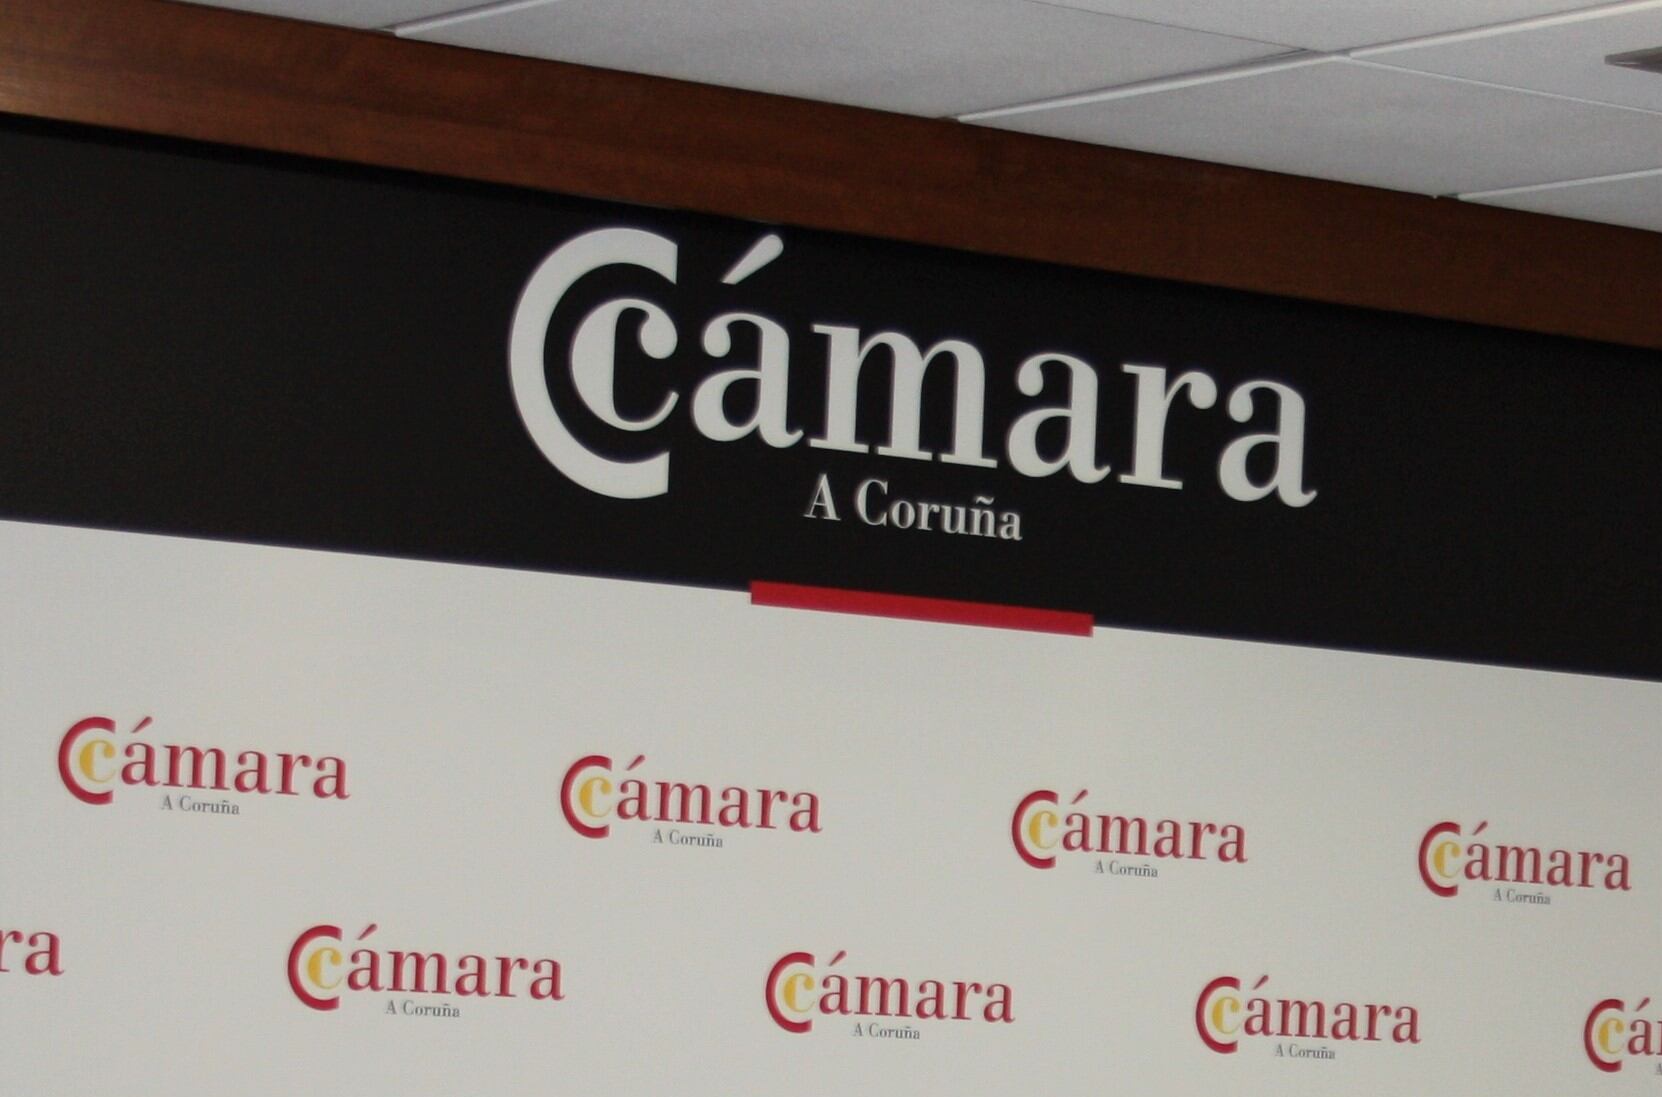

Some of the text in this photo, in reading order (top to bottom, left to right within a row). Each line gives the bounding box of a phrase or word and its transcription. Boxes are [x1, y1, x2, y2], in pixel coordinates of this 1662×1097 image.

[804, 473, 1022, 541] A Coruña
[161, 794, 240, 816] A Coruña
[653, 829, 723, 849] A Coruña
[1095, 860, 1159, 878] A Coruña
[1494, 888, 1551, 905] A Coruña
[385, 1000, 461, 1018] A Coruña
[853, 1022, 921, 1040] A Coruña
[1275, 1043, 1336, 1060] A Coruña
